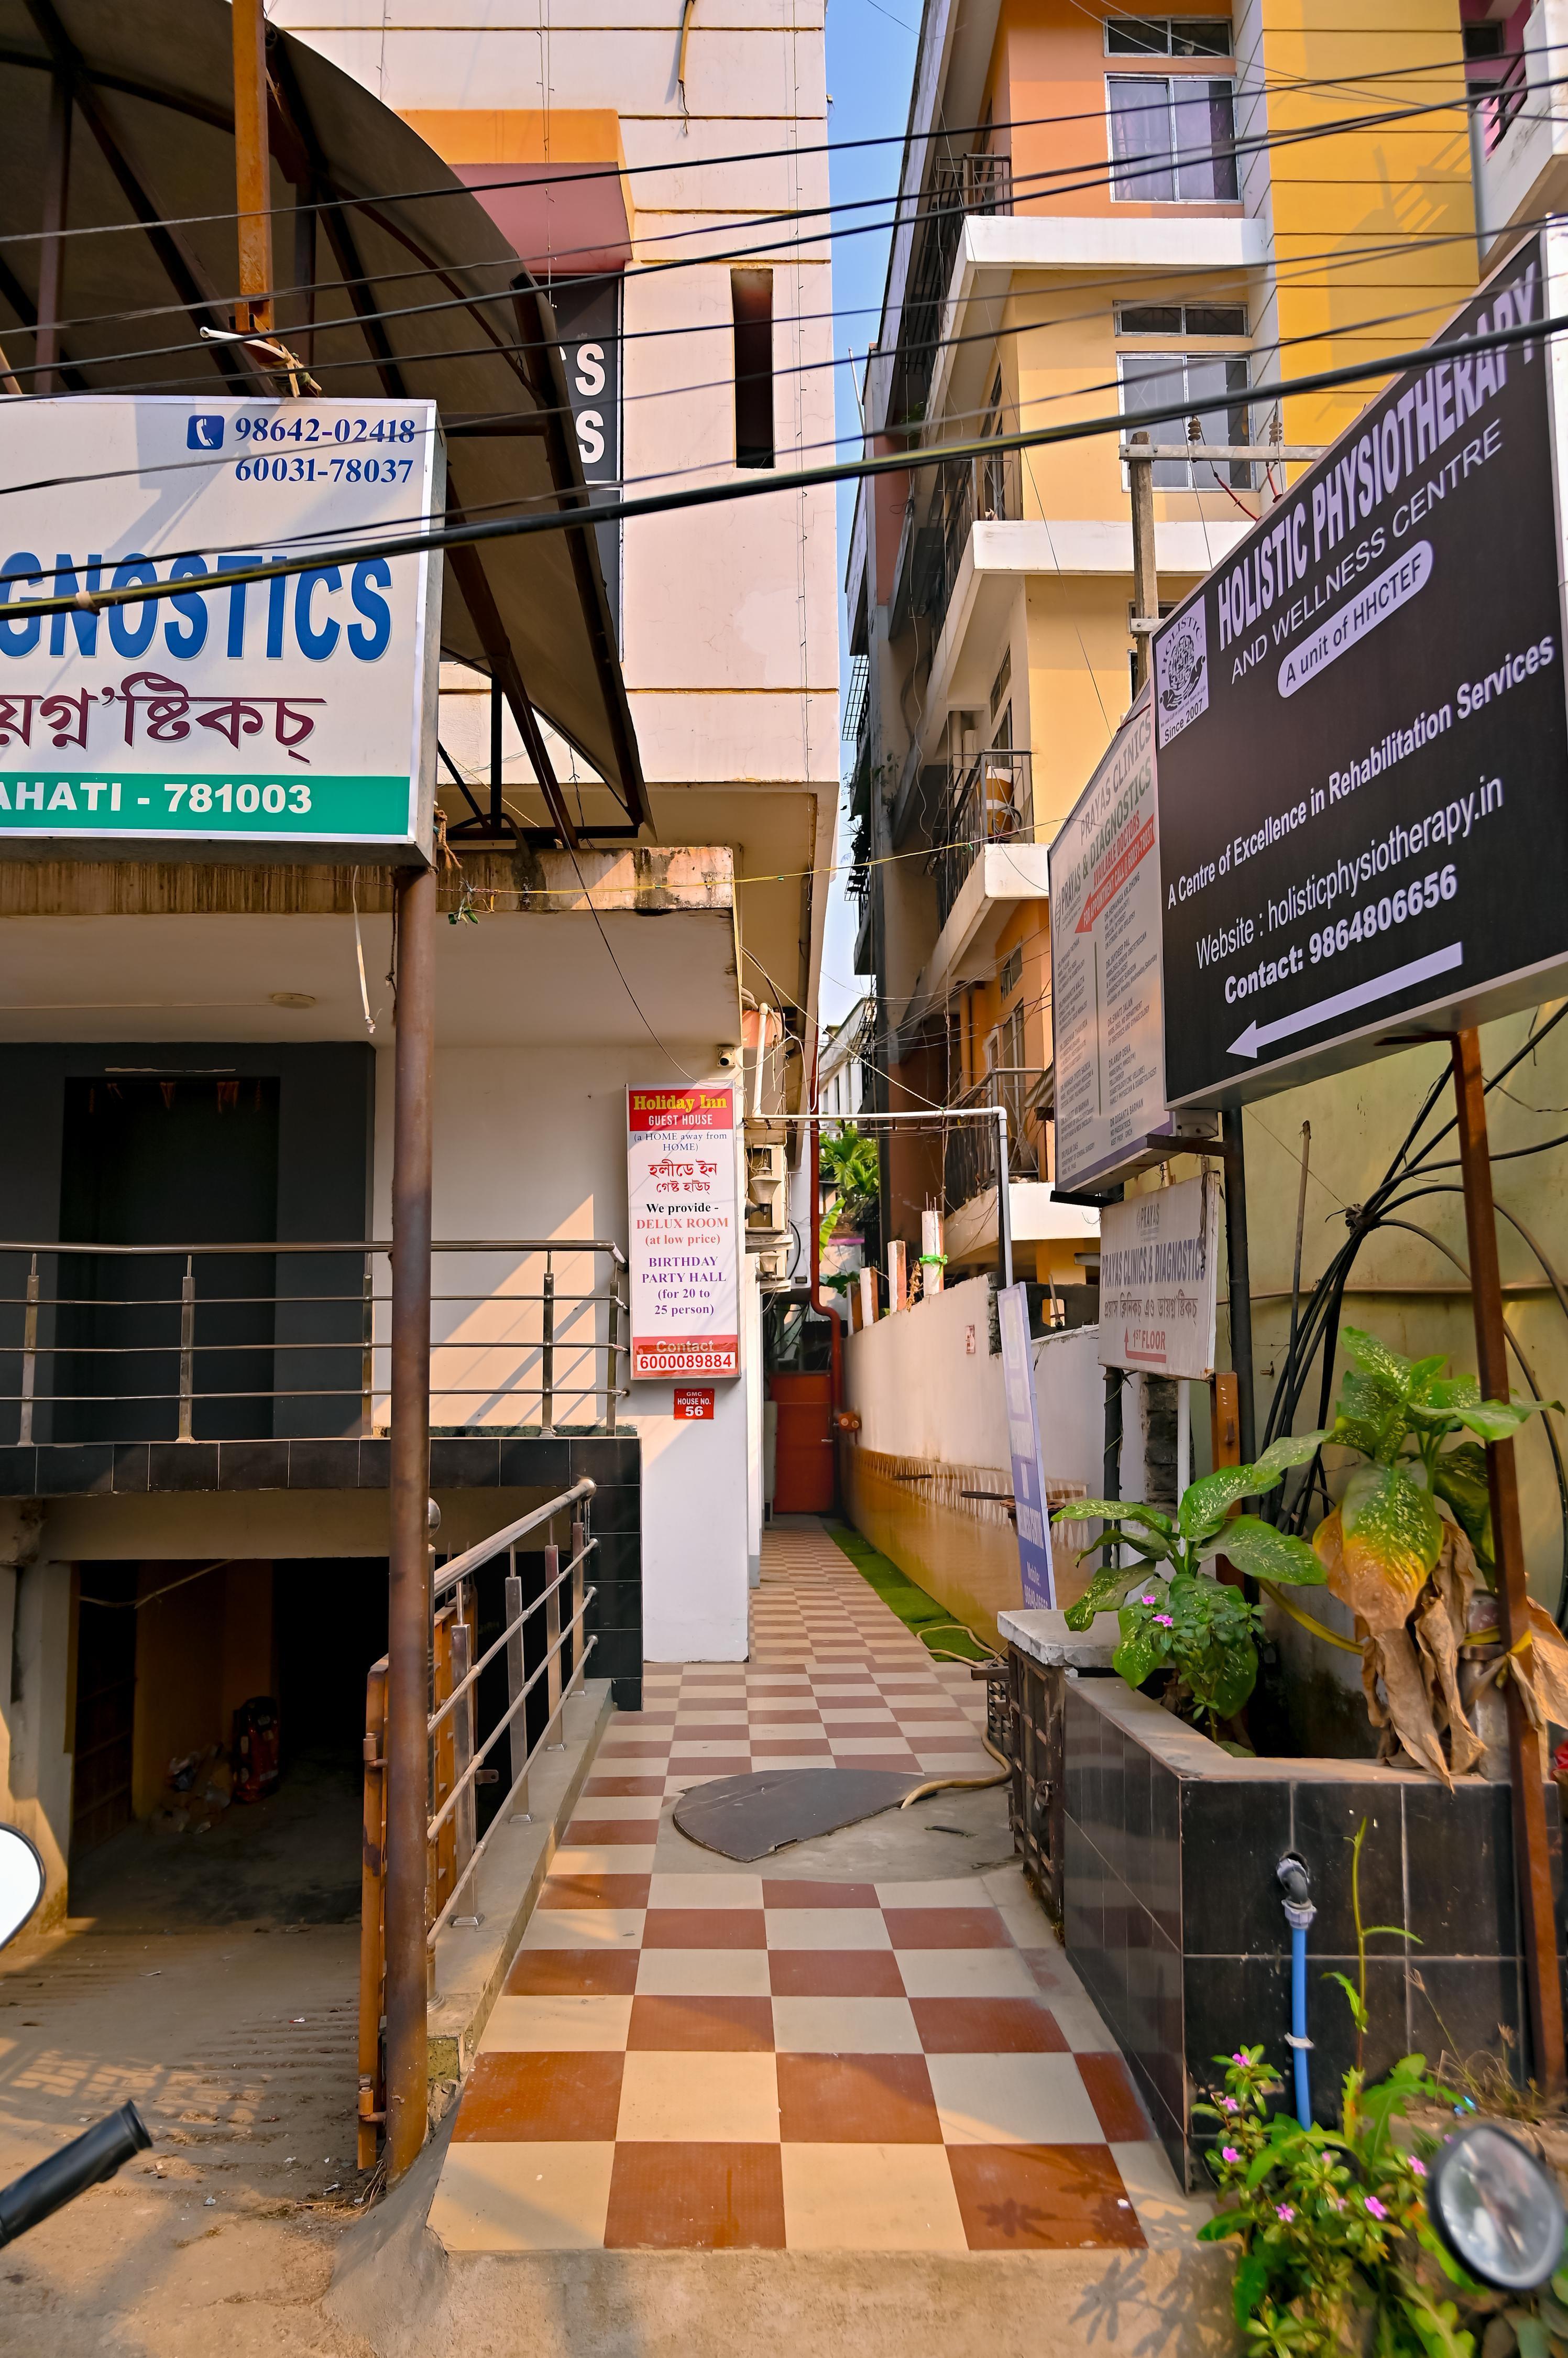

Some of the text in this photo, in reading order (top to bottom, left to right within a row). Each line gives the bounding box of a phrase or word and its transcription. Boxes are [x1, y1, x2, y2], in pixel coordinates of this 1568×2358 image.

[559, 343, 605, 396] S
[235, 418, 415, 444] 98642-02418
[1218, 262, 1537, 651] HOLISTIC PHYSIOTHERAPY
[235, 458, 413, 483] 60031-78037
[1232, 418, 1504, 684] AND WELLNESS CENTRE
[1285, 555, 1422, 686] A unit of HHCTEF
[1161, 616, 1203, 675] HOLISTIC
[1165, 698, 1203, 742] Since 2007
[1080, 707, 1151, 847] PRAYAS CLINICS
[1168, 636, 1554, 910] A Centre of Excellence in Rehabilitation Services
[163, 783, 313, 813] 781003
[1082, 754, 1151, 882] & DIAGNOSTICS
[1093, 807, 1139, 890] AVAILABLE DOCTORS
[1197, 914, 1254, 970] Website
[1268, 775, 1504, 933] holisticphysiotherapy.in
[1061, 860, 1081, 915] PRAYAS
[1091, 872, 1114, 920] APPOINTMENT
[1114, 859, 1124, 889] CALL
[1224, 864, 1457, 1005] Contact: 9864806656
[633, 1094, 727, 1113] Holiday Inn
[649, 1114, 712, 1126] GUEST HOUSE
[634, 1133, 642, 1142] (a
[706, 1131, 727, 1140] from
[663, 1143, 698, 1152] HOME)
[646, 1204, 664, 1213] We
[668, 1203, 711, 1215] provide
[1141, 1203, 1159, 1229] PRAYAS
[637, 1218, 728, 1229] DELUX ROOM
[645, 1234, 720, 1247] (at low price)
[649, 1257, 718, 1267] BIRTHDAY
[1102, 1251, 1122, 1288] PRAYAS
[1123, 1247, 1146, 1286] CLINICS
[1148, 1246, 1153, 1284] &
[642, 1272, 727, 1283] PARTY HALL
[658, 1289, 710, 1301] (for 20 to
[654, 1304, 714, 1317] 25 person)
[656, 1340, 714, 1352] Contact
[1142, 1330, 1165, 1350] FLOOR
[640, 1354, 732, 1369] 6000089884
[685, 1406, 704, 1416] 56
